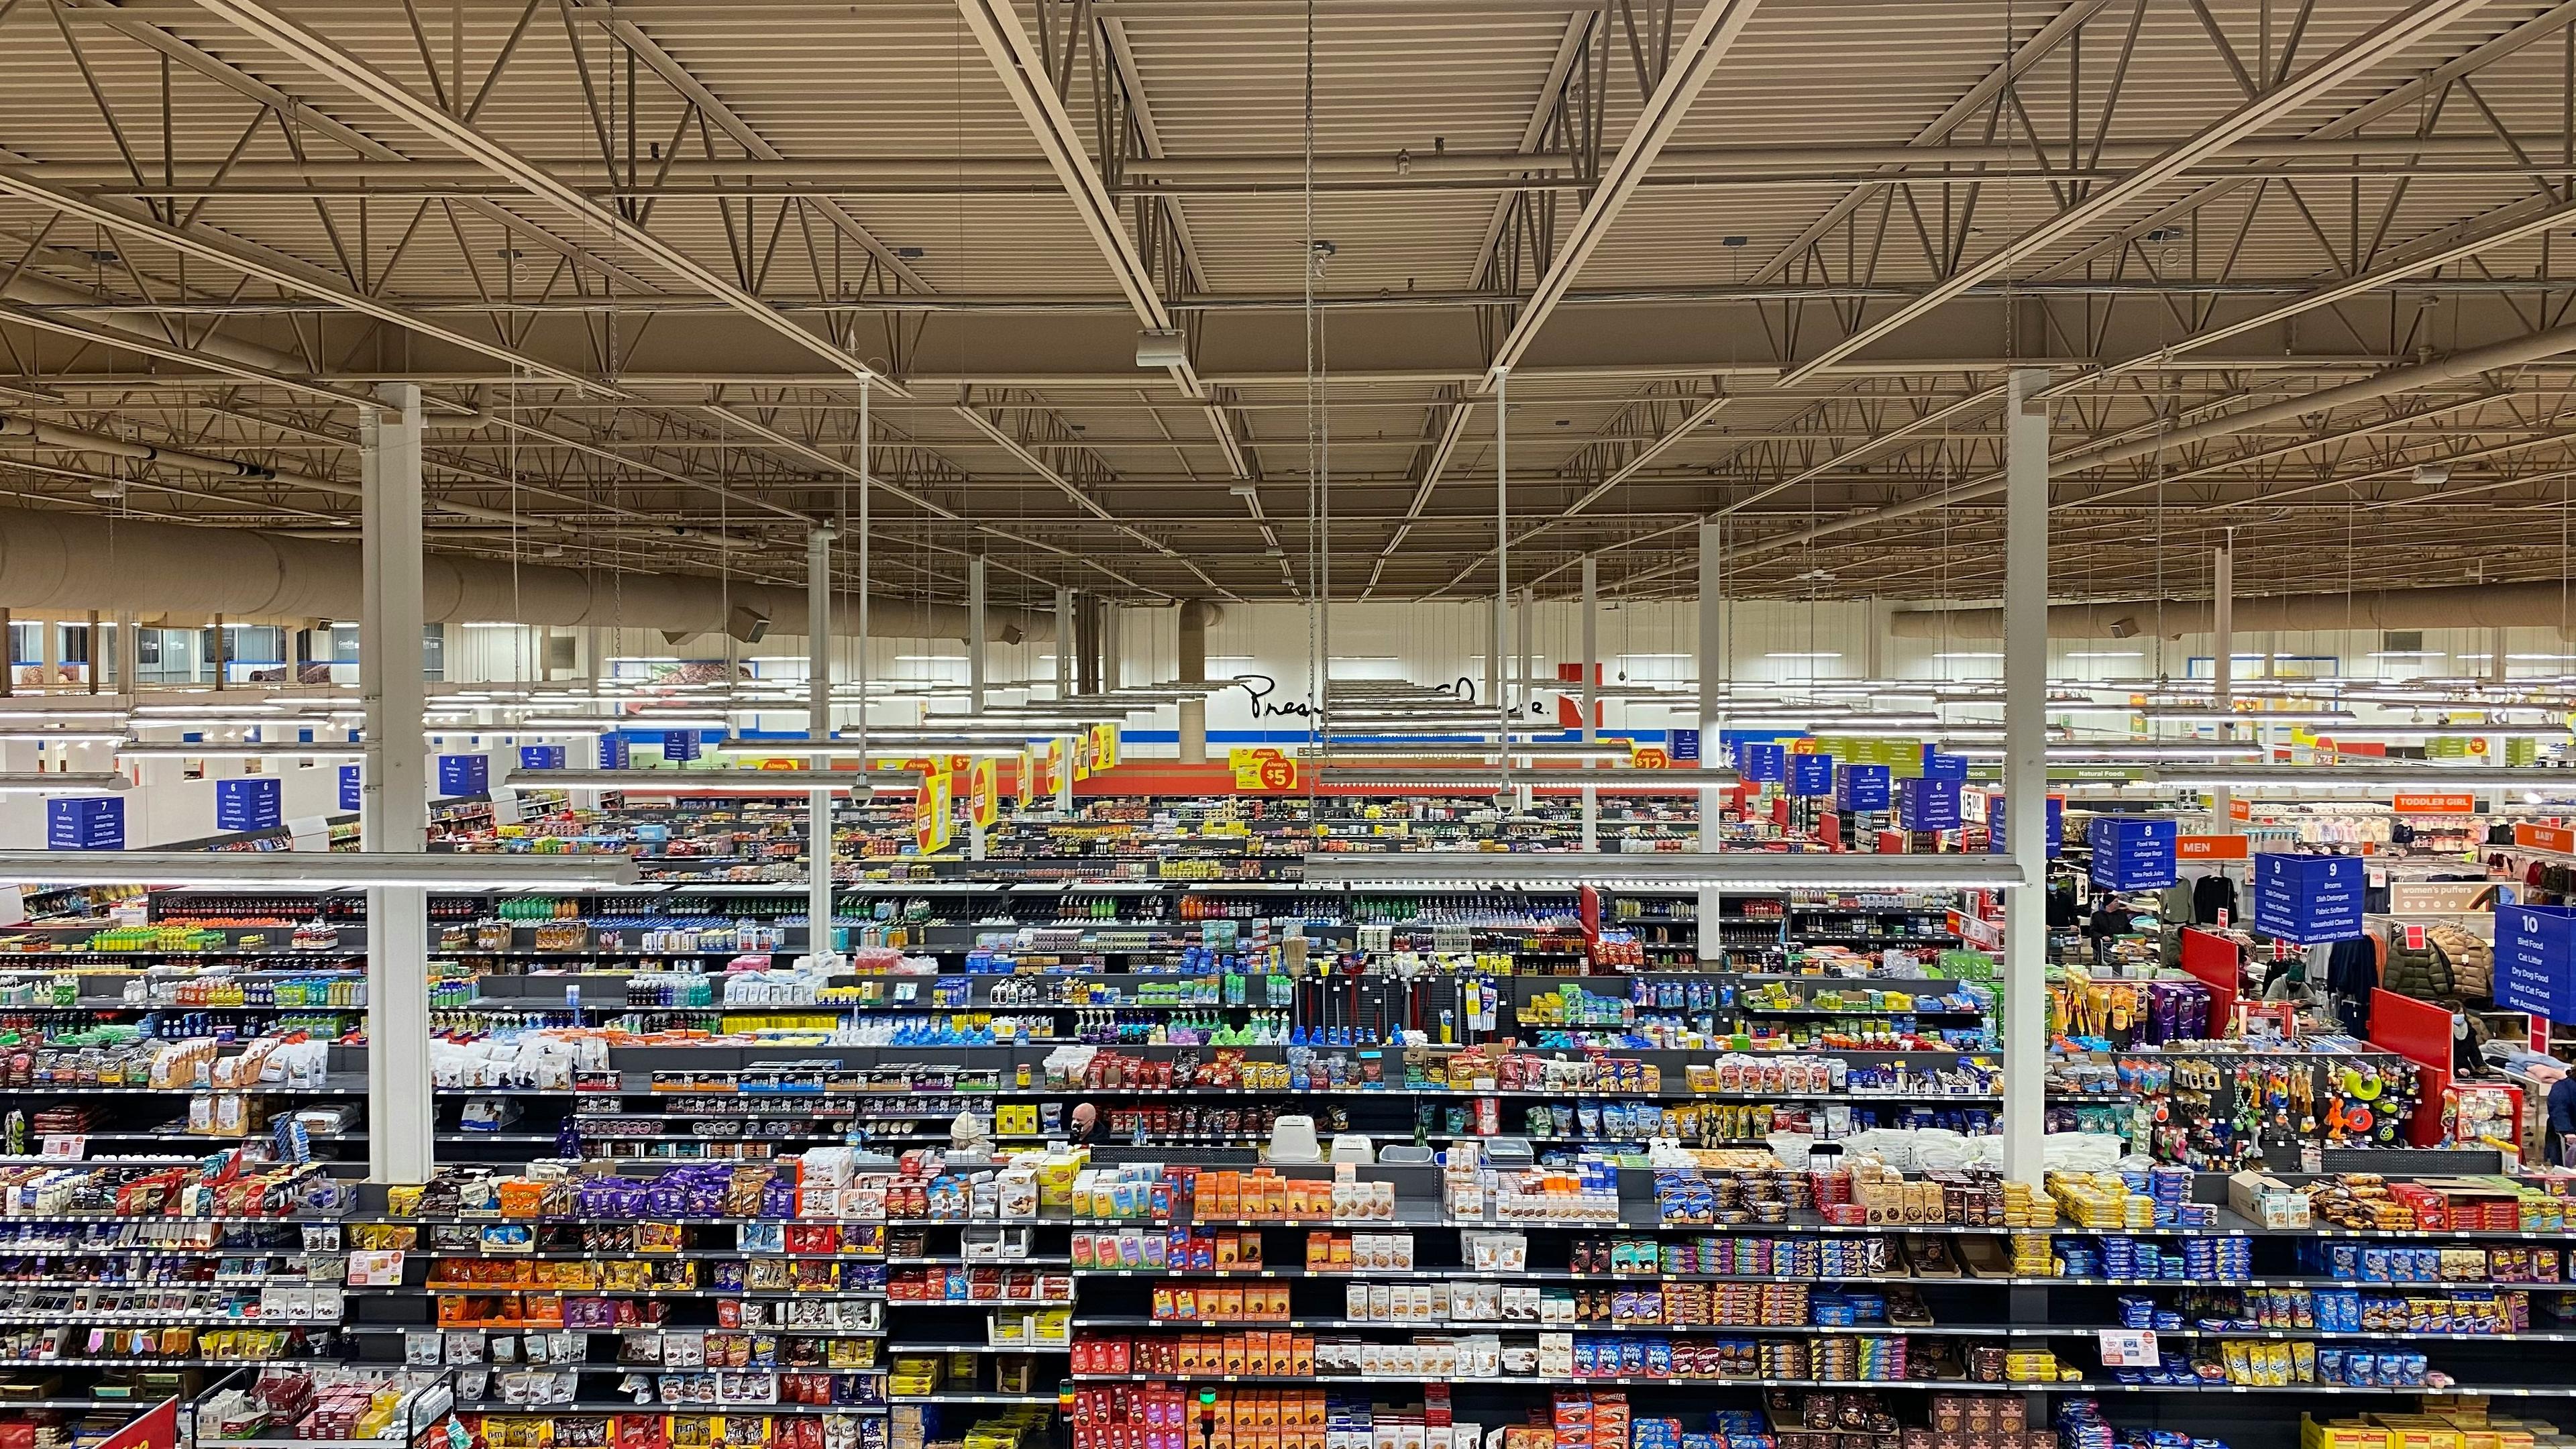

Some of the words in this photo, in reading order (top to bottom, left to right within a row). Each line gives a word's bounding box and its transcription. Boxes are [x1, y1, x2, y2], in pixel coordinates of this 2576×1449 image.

[2471, 741, 2483, 751] $5
[908, 761, 929, 769] Always
[1636, 757, 1662, 769] $12
[1267, 769, 1286, 786] $5
[231, 784, 236, 792] 6
[263, 782, 268, 791] 6
[975, 784, 985, 796] CLUB
[1936, 782, 1942, 791] 6
[101, 801, 107, 811] 7
[975, 794, 985, 808] SIZE
[2000, 801, 2004, 810] 7
[2400, 797, 2445, 806] TODDLER
[2446, 797, 2469, 806] GIRL
[62, 802, 67, 812] 7
[918, 802, 930, 817] CLUB
[918, 814, 931, 833] SIZE
[2103, 824, 2108, 835] 8
[2144, 825, 2152, 837] 8
[2535, 830, 2555, 842] BABY
[2184, 843, 2210, 853] MEN
[2274, 861, 2281, 874] 9
[2329, 863, 2337, 877] 9
[2271, 878, 2285, 888] Brooms
[2402, 885, 2439, 894] women's
[2440, 885, 2472, 895] puffers
[2326, 894, 2349, 902] Detergent
[2330, 906, 2349, 914] Softener
[2310, 920, 2334, 928] Household
[2334, 918, 2353, 926] Cleaners
[2522, 916, 2538, 933] 10
[2304, 934, 2318, 942] Liquid
[2319, 931, 2337, 941] Laundry
[2337, 930, 2359, 939] Detergent
[2518, 937, 2529, 947] Bird
[2529, 940, 2544, 950] Food
[2518, 953, 2528, 962] Cat
[2528, 955, 2543, 965] Litter
[2512, 967, 2522, 977] Dry
[2522, 969, 2534, 981] Dog
[2534, 973, 2549, 983] Food
[2510, 981, 2525, 992] Moist
[2525, 985, 2535, 995] Cat
[2535, 988, 2550, 999] Food
[2510, 997, 2519, 1006] Pet
[2519, 999, 2551, 1015] Accessories
[1656, 1177, 1679, 1186] Whippet
[1665, 1197, 1688, 1205] Whippet
[1690, 1197, 1712, 1205] Whippet
[1613, 1248, 1635, 1256] Whippet
[1635, 1247, 1658, 1256] Whippet
[1614, 1297, 1637, 1307] Whippet
[1639, 1297, 1661, 1307] Whippet
[1672, 1352, 1695, 1361] Whippet
[1697, 1352, 1719, 1360] Whippet
